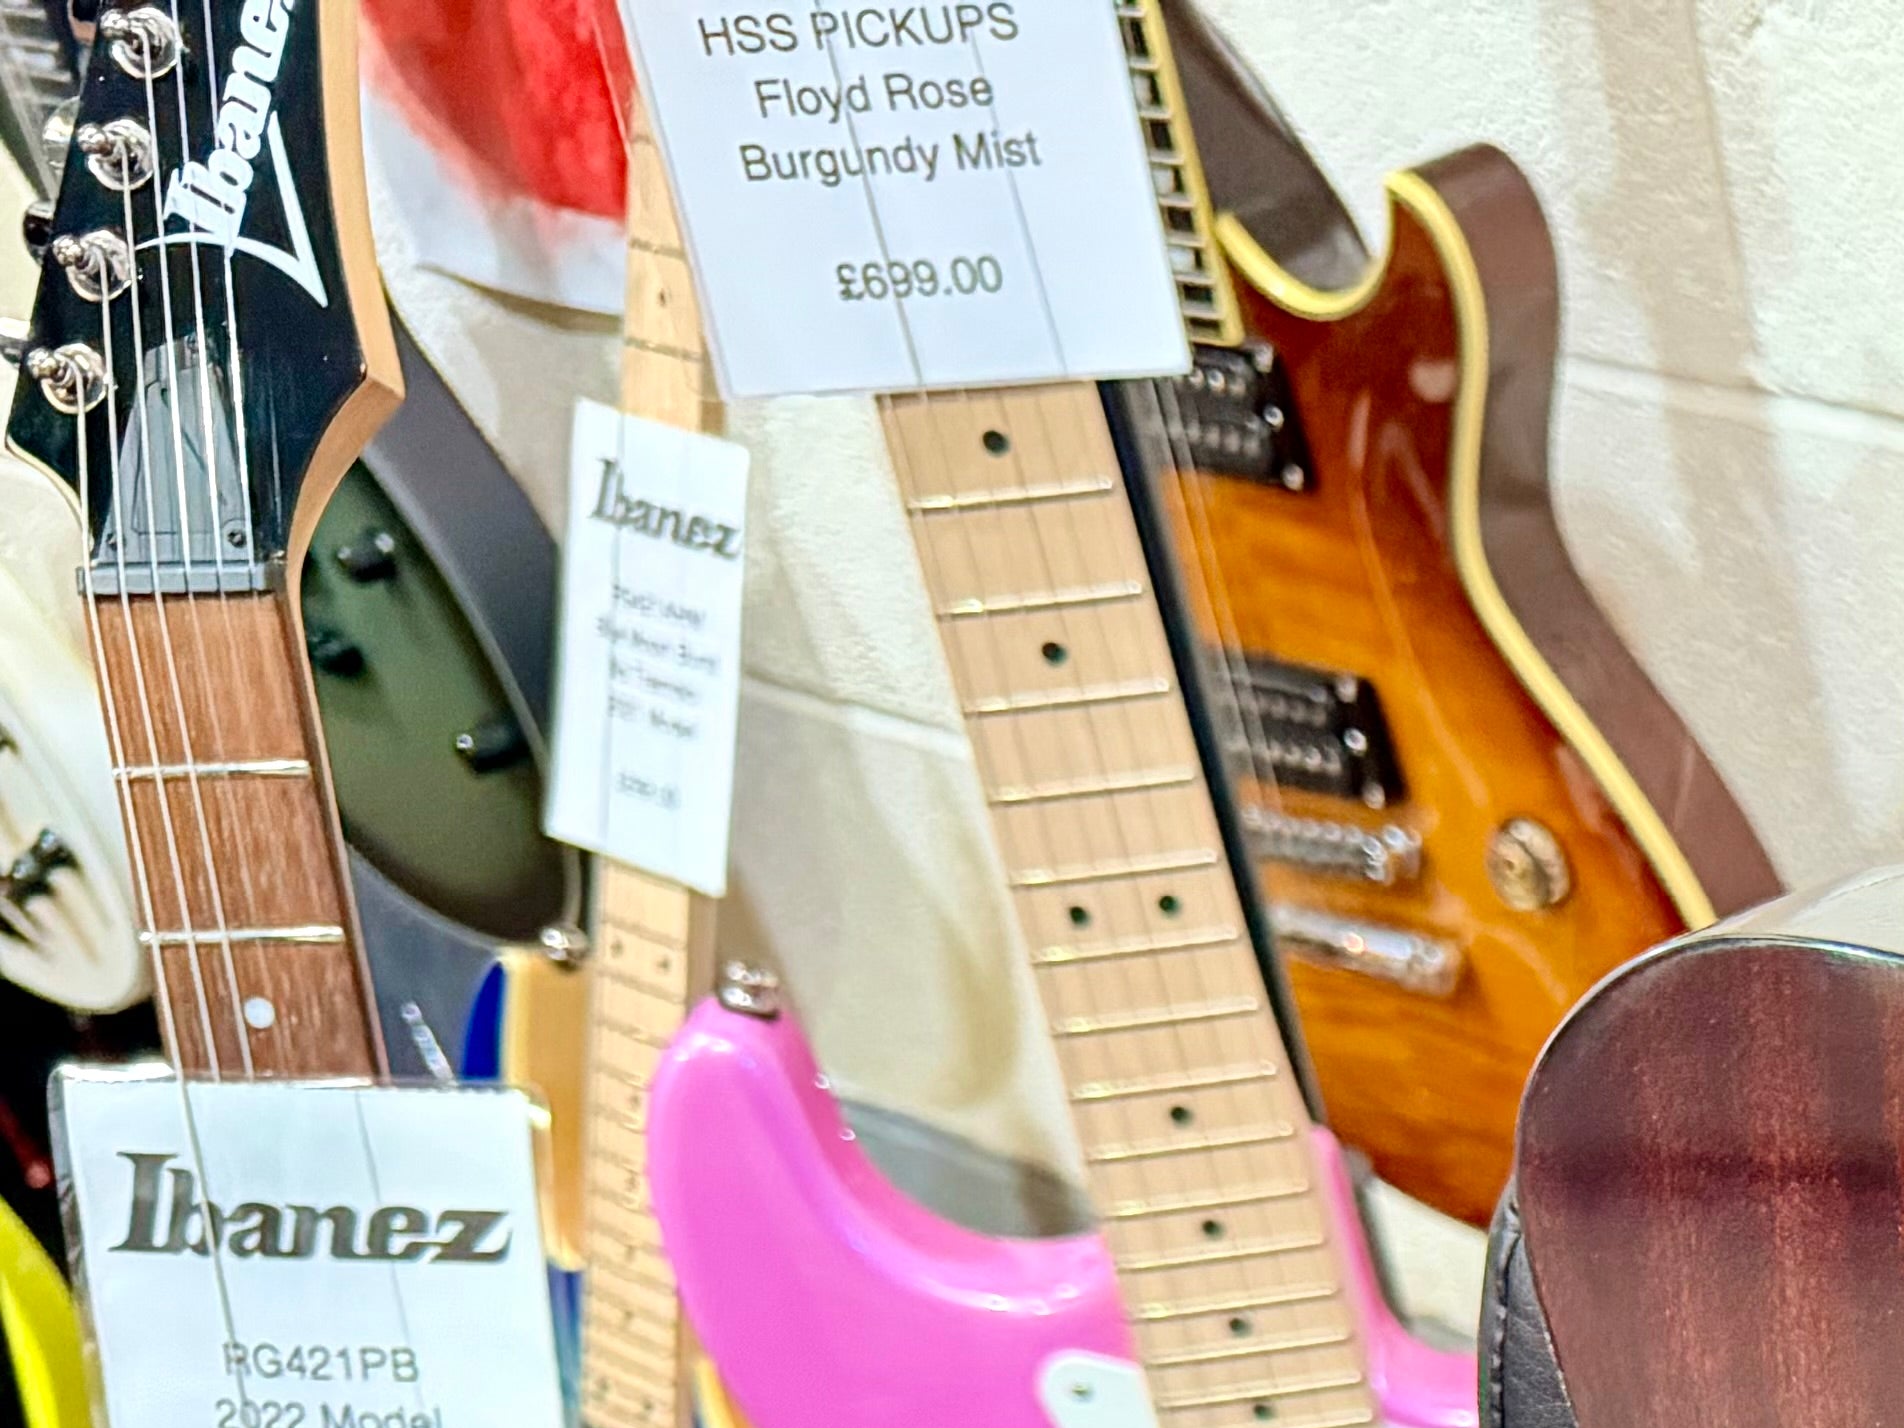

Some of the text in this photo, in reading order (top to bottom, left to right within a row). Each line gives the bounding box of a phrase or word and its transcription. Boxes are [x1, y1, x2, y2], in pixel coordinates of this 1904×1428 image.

[698, 2, 1020, 57] HSS PICKUPS
[754, 74, 995, 124] Floyd Rose
[163, 0, 295, 256] Ibane
[739, 130, 1042, 188] Burgundy Mist
[836, 255, 1003, 301] £699.00
[589, 455, 744, 561] Ibanez
[108, 1151, 514, 1264] Ibanez
[222, 1342, 420, 1383] RG421PB
